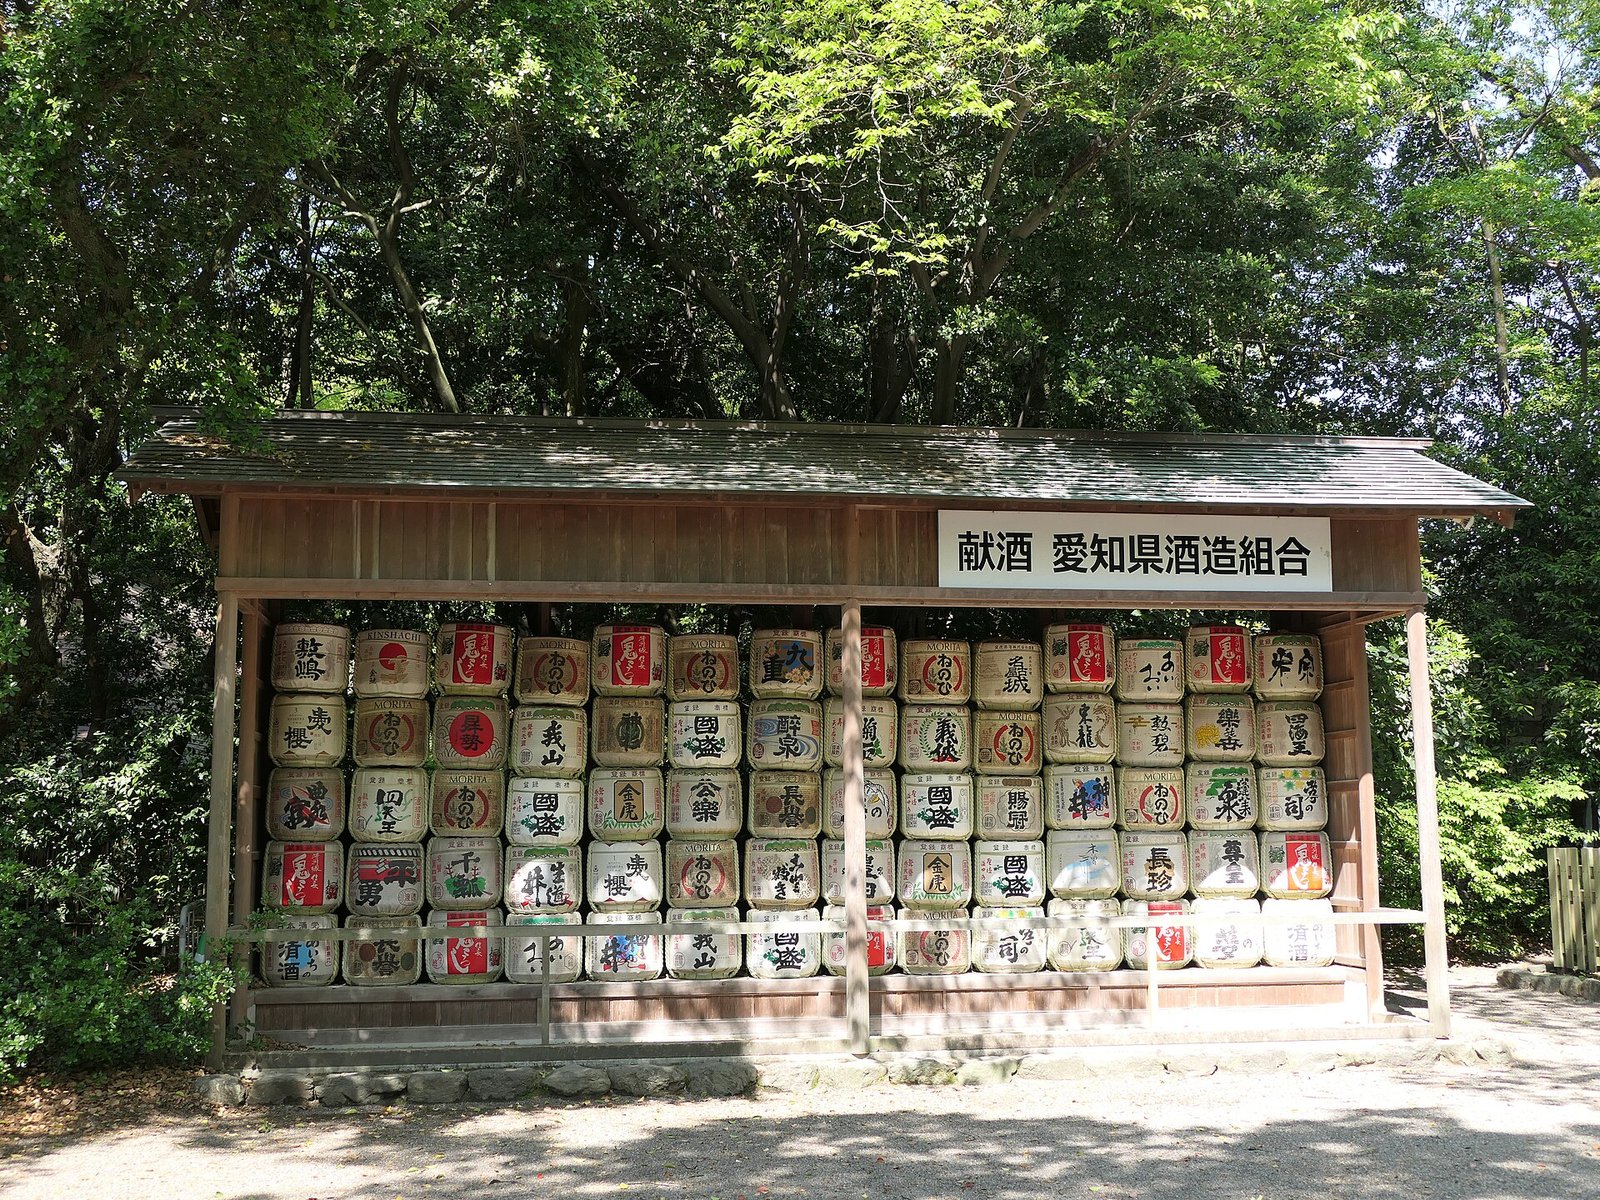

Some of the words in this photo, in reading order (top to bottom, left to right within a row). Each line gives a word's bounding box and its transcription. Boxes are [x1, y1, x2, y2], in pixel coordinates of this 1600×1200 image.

[958, 530, 1033, 572] 献酒
[1052, 532, 1311, 576] 愛知県酒造組合
[367, 631, 421, 642] KINSHACHI
[539, 641, 577, 650] MORITA
[690, 640, 726, 648] MORITA
[548, 651, 565, 695] ねのひ
[701, 650, 718, 694] ねのひ
[762, 643, 815, 684] 九重
[937, 654, 952, 696] ねのひ
[374, 700, 413, 709] MORITA
[999, 712, 1033, 721] MORITA
[1076, 703, 1098, 748] 東龍
[384, 711, 400, 756] ねのひ
[541, 720, 566, 766] 我山
[694, 716, 722, 760] 國盛
[1008, 722, 1024, 766] ねのひ
[450, 775, 488, 784] MORITA
[1144, 772, 1177, 781] MORITA
[458, 786, 476, 830] ねのひ
[533, 793, 561, 838] 國盛
[618, 783, 641, 820] 金虎
[928, 786, 956, 830] 國盛
[1154, 783, 1169, 825] ねのひ
[685, 844, 722, 852] MORITA
[695, 854, 712, 899] ねのひ
[928, 856, 950, 892] 金虎
[1003, 856, 1031, 898] 國盛
[1146, 848, 1172, 892] 長珍
[922, 911, 958, 920] MORITA
